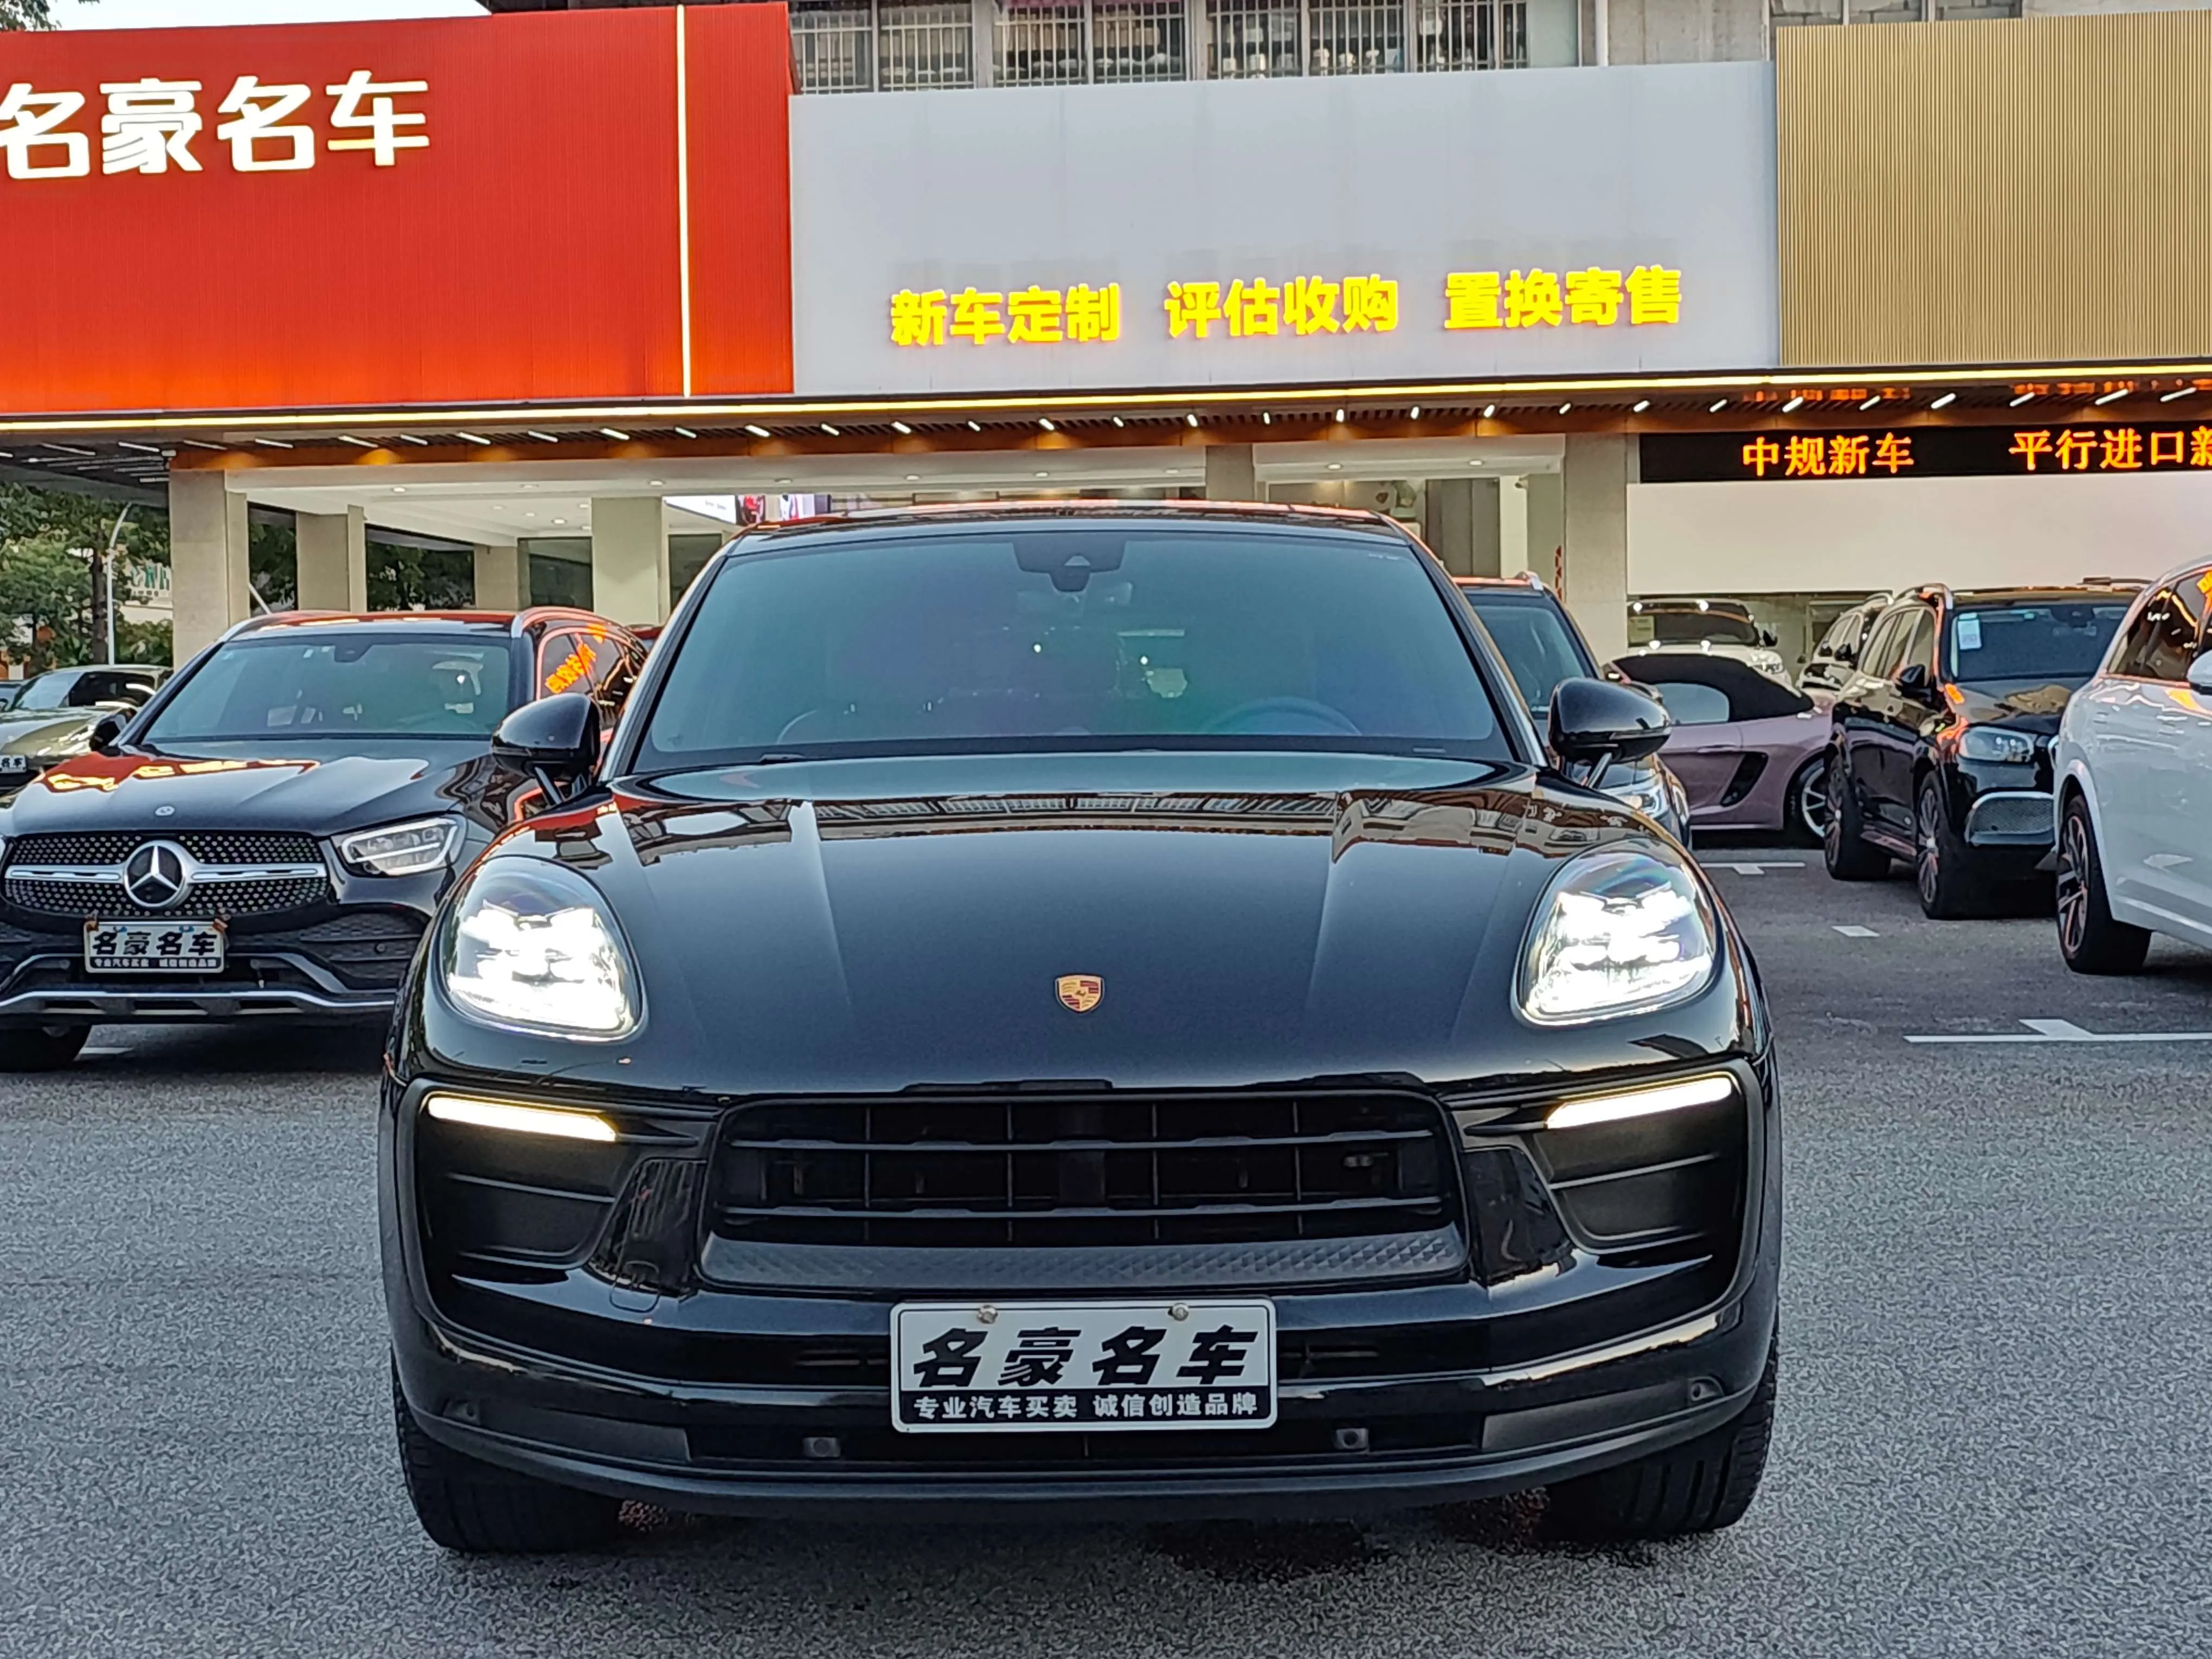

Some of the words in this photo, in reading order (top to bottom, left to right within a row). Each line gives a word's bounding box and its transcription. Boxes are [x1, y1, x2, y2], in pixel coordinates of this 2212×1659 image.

[0, 70, 429, 179] 名豪名车
[890, 285, 1120, 348] 新车定制
[1164, 275, 1397, 339] 评估收购
[1444, 266, 1681, 330] 置换寄售
[1742, 432, 1914, 476] 中规新车
[92, 931, 217, 956] 名豪名车
[913, 1324, 1259, 1387] 名豪名车
[914, 1395, 1078, 1419] 专业汽车买卖
[1092, 1392, 1258, 1418] 诚信创造品牌
